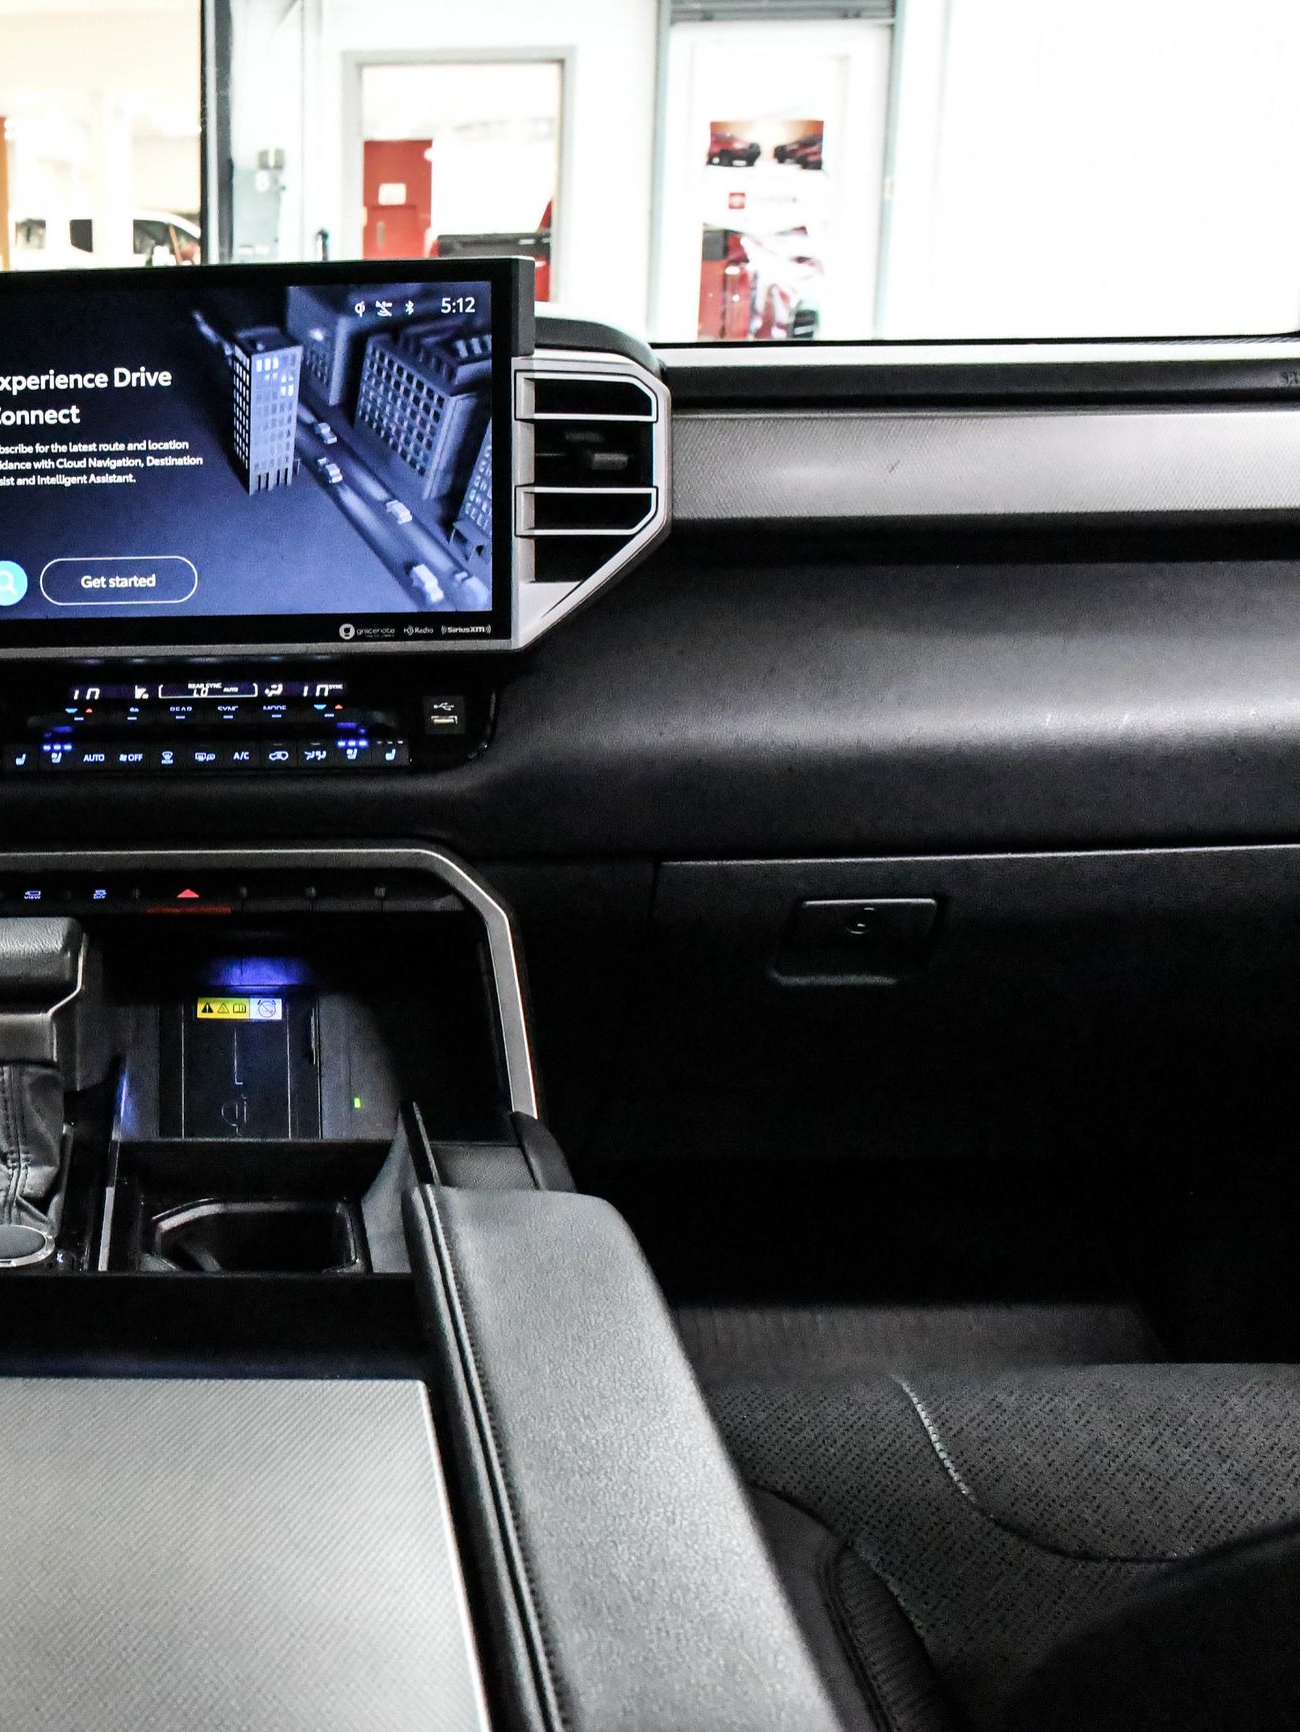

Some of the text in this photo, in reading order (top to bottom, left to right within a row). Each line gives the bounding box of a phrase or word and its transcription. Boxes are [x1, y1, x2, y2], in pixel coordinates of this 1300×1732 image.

[441, 297, 476, 314] 5:12
[114, 366, 172, 388] Drive
[35, 443, 50, 454] for
[50, 442, 67, 453] the
[69, 442, 97, 452] latest
[99, 442, 125, 452] route
[127, 440, 146, 450] and
[148, 440, 188, 450] location
[33, 459, 55, 469] with
[56, 458, 86, 468] Cloud
[88, 457, 144, 470] Navigation,
[146, 456, 203, 466] Destination
[16, 475, 35, 486] and
[37, 474, 87, 486] Intelligent
[89, 473, 136, 484] Assistant.
[81, 574, 156, 588] Get started
[83, 753, 105, 762] AUTO
[128, 753, 143, 762] OFF
[233, 752, 250, 761] A/C
